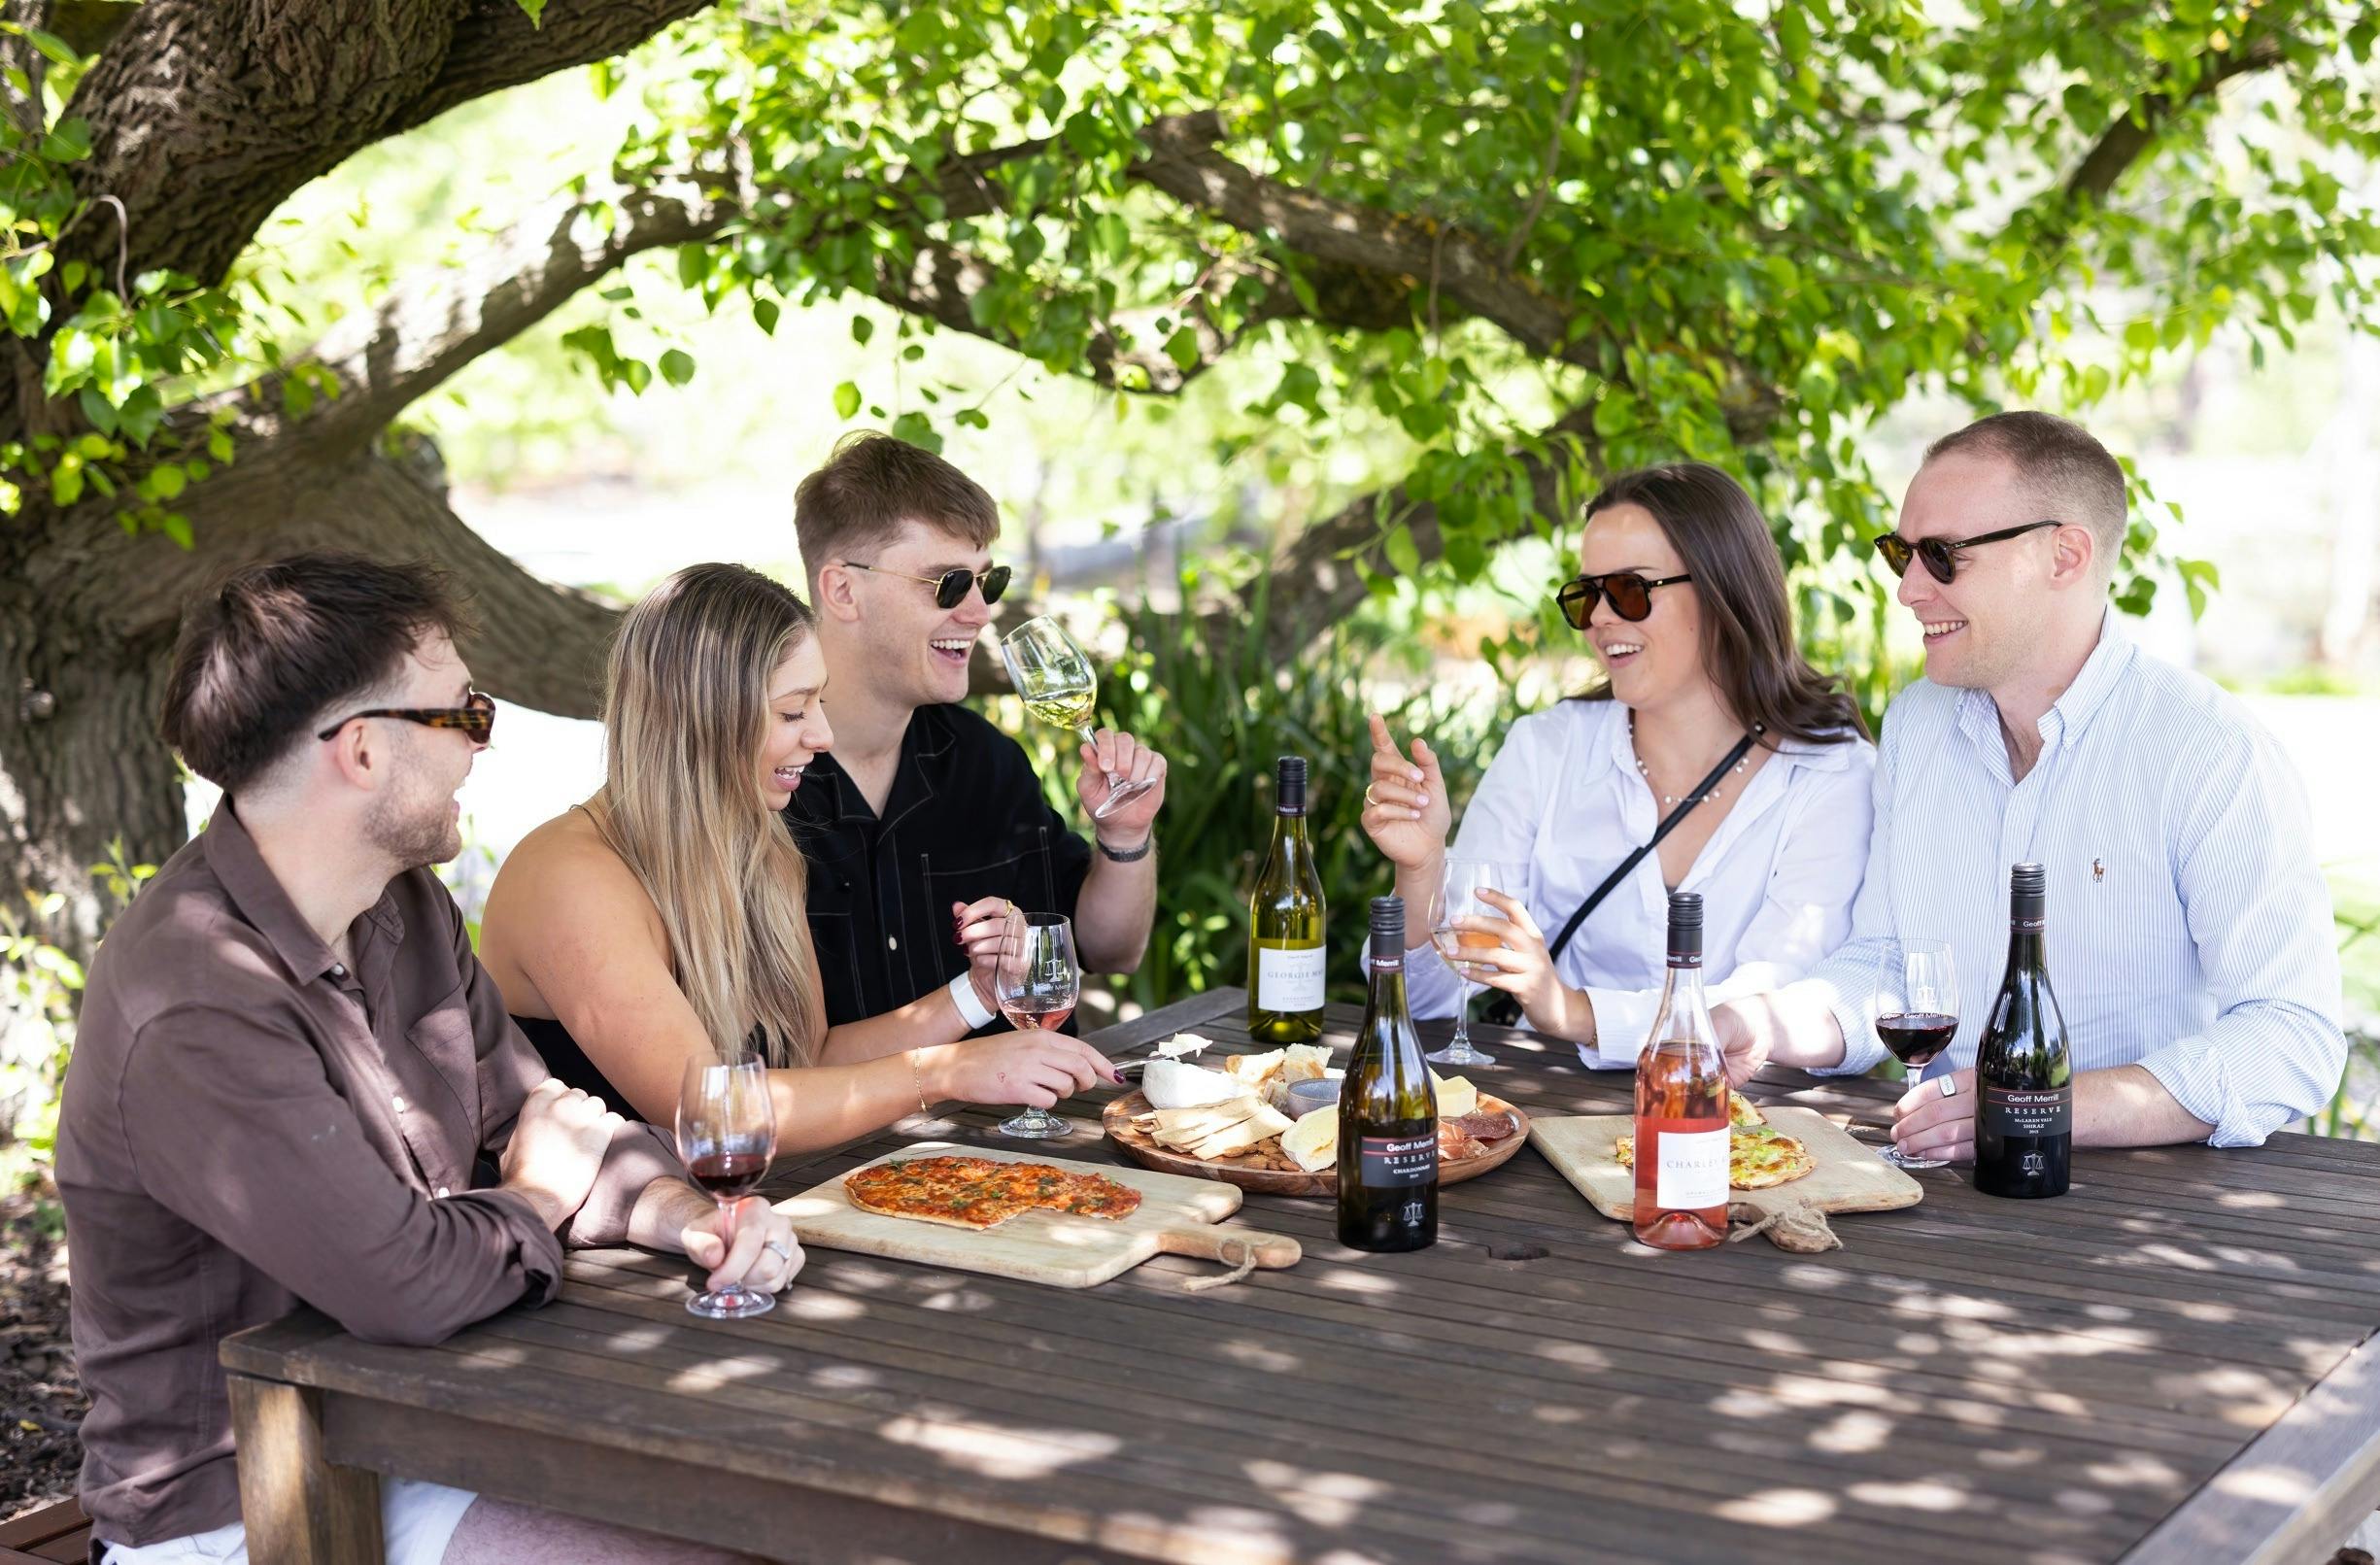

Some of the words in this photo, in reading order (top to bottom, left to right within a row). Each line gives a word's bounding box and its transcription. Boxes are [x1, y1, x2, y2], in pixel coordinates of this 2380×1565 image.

[2007, 1094, 2032, 1103] Geoff
[2034, 1093, 2059, 1103] Merrill
[2005, 1106, 2060, 1115] RESERVE
[1386, 1142, 1412, 1152] Geoff
[1412, 1137, 1435, 1149] Merrill
